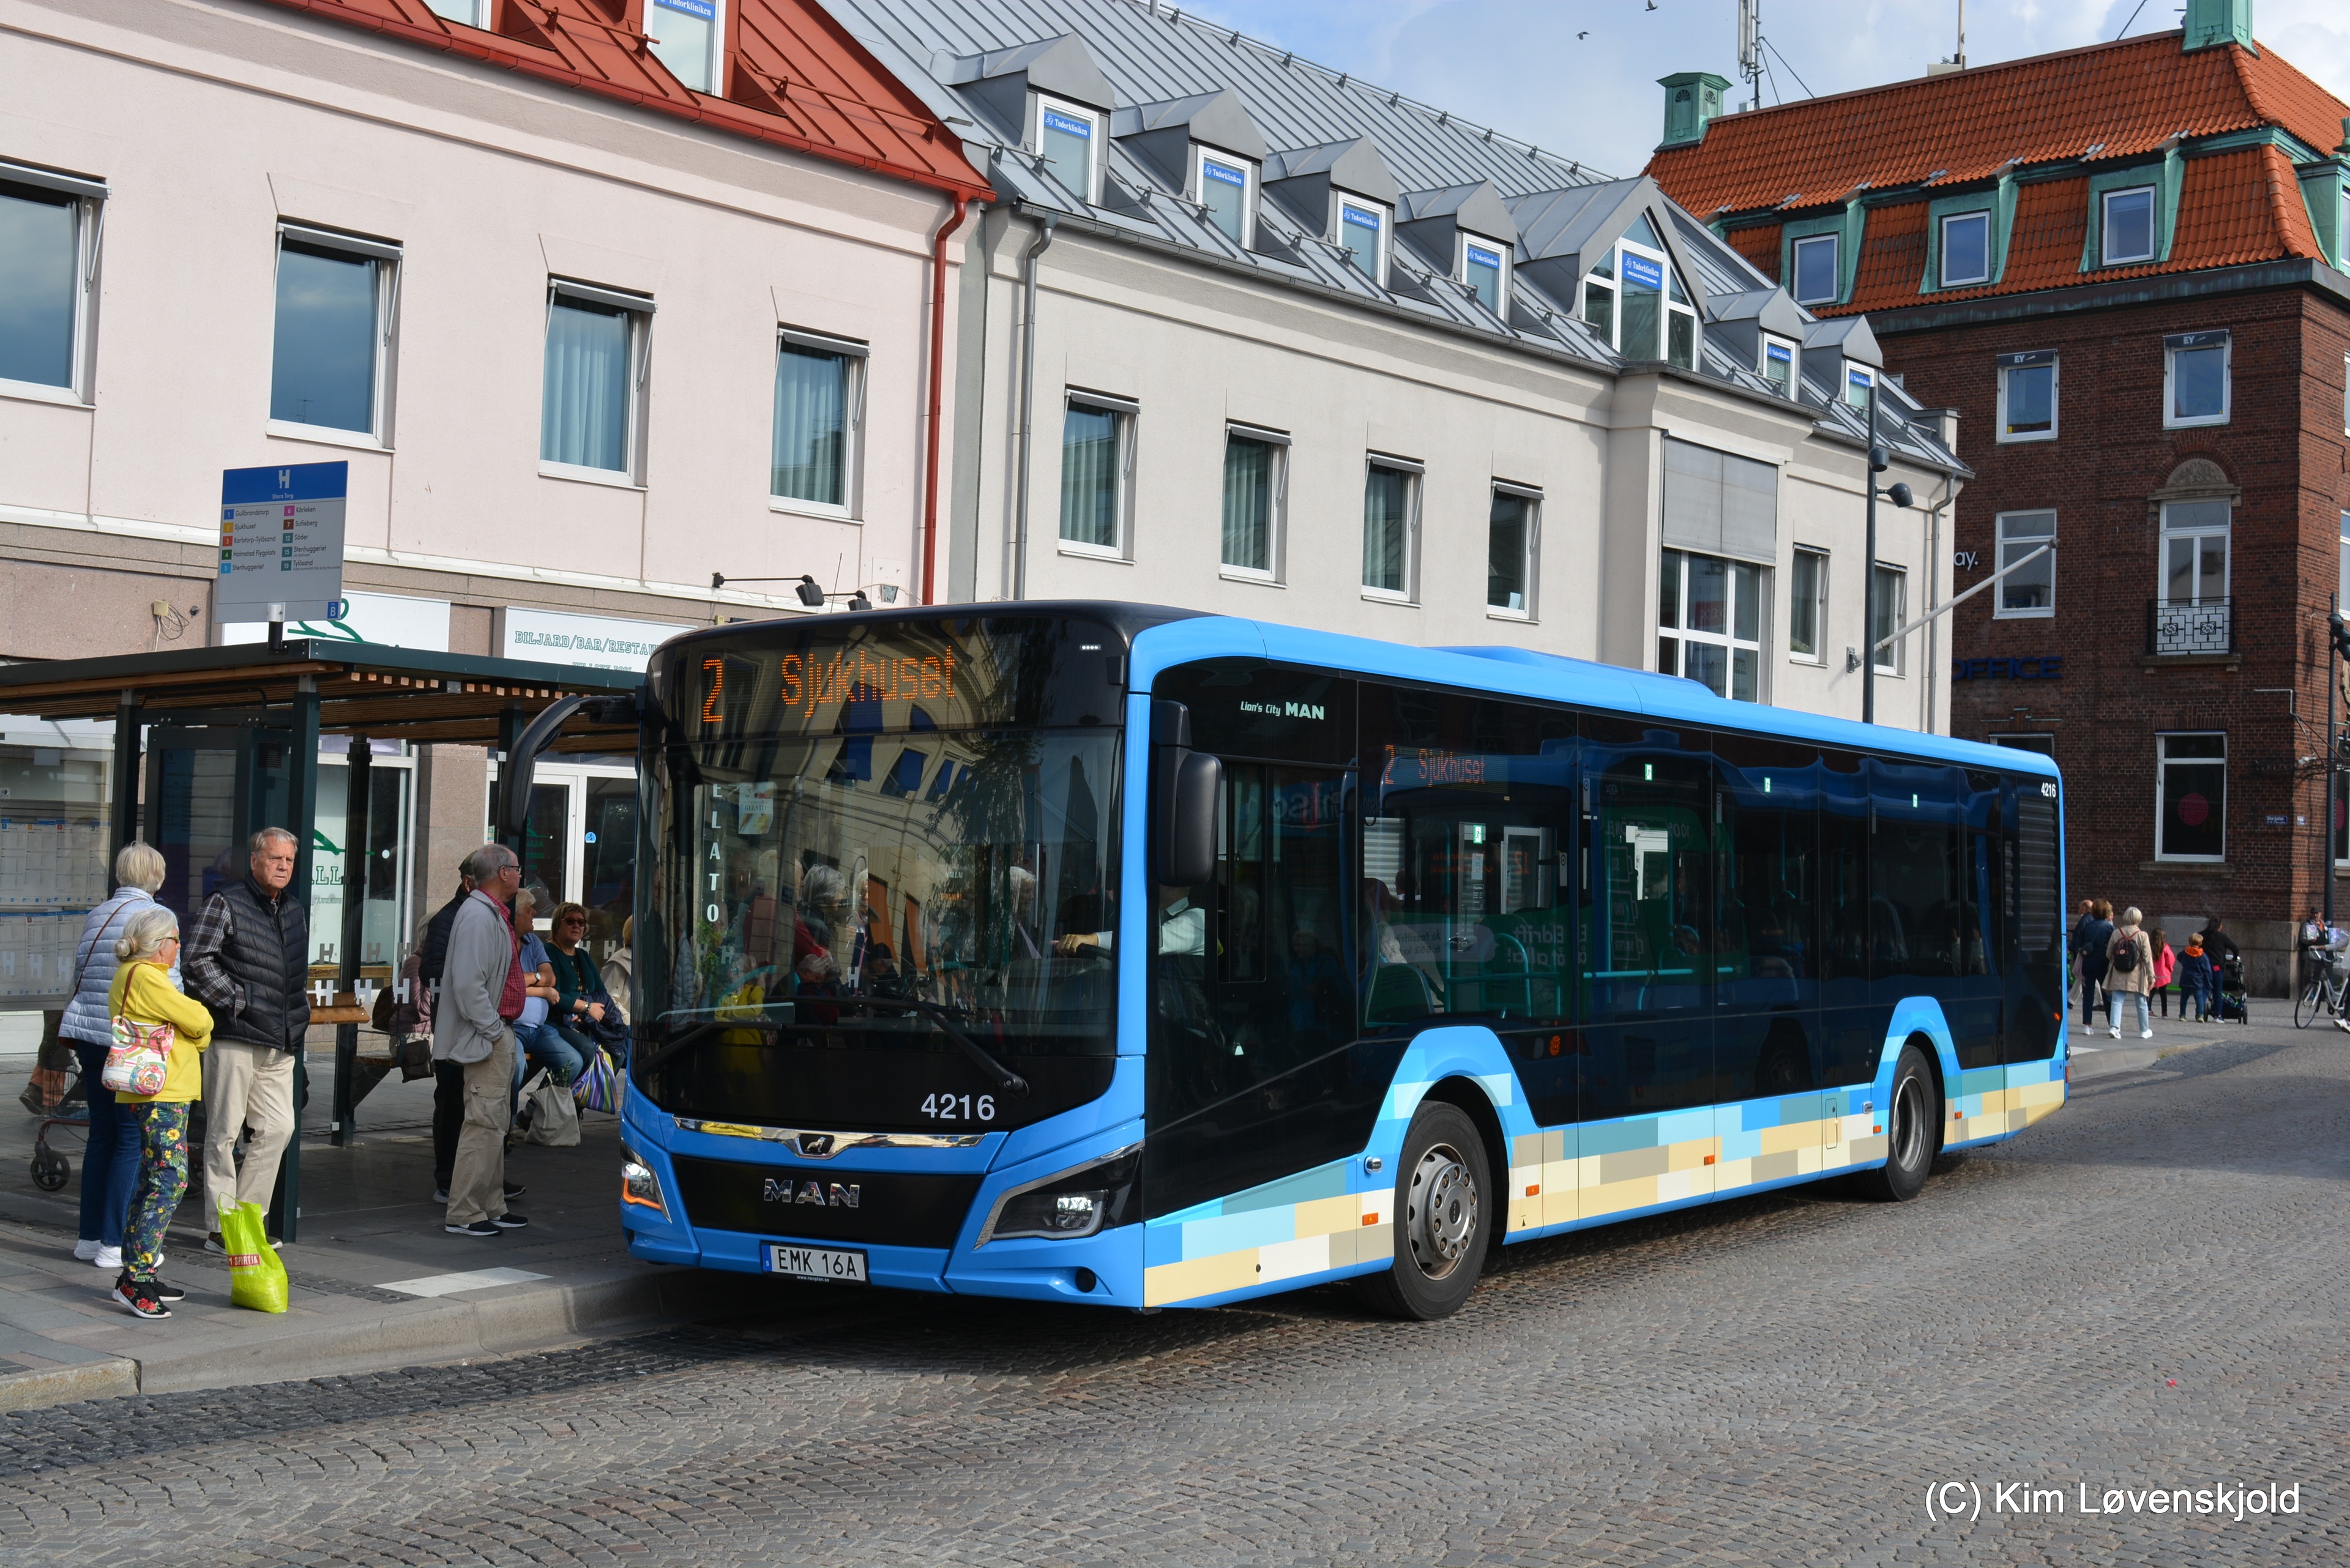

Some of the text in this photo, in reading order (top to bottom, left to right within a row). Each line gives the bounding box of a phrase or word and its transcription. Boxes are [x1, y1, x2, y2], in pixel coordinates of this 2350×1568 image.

[1054, 118, 1087, 136] Tudorkliniken
[1212, 168, 1242, 184] Tudorkliniken
[1474, 250, 1498, 266] Tudorkliniken
[1632, 261, 1659, 277] Tudorkliniken
[2183, 335, 2195, 345] EY
[2014, 354, 2025, 364] EY
[278, 469, 291, 489] H
[234, 535, 276, 544] Karlstorp-Tylösand
[330, 607, 336, 616] B
[703, 646, 956, 722] 2 Sjukhuset
[1240, 701, 1324, 720] Lion's City MAN
[1385, 745, 1486, 788] 2 Sjukhuset
[2041, 782, 2056, 798] 4216
[311, 866, 344, 885] LL
[315, 979, 334, 1007] H
[353, 979, 373, 1006] H
[392, 978, 410, 1004] H
[430, 977, 443, 1004] H
[921, 1094, 994, 1121] 4216
[764, 1178, 860, 1208] MAN
[778, 1249, 857, 1277] EMK 16A
